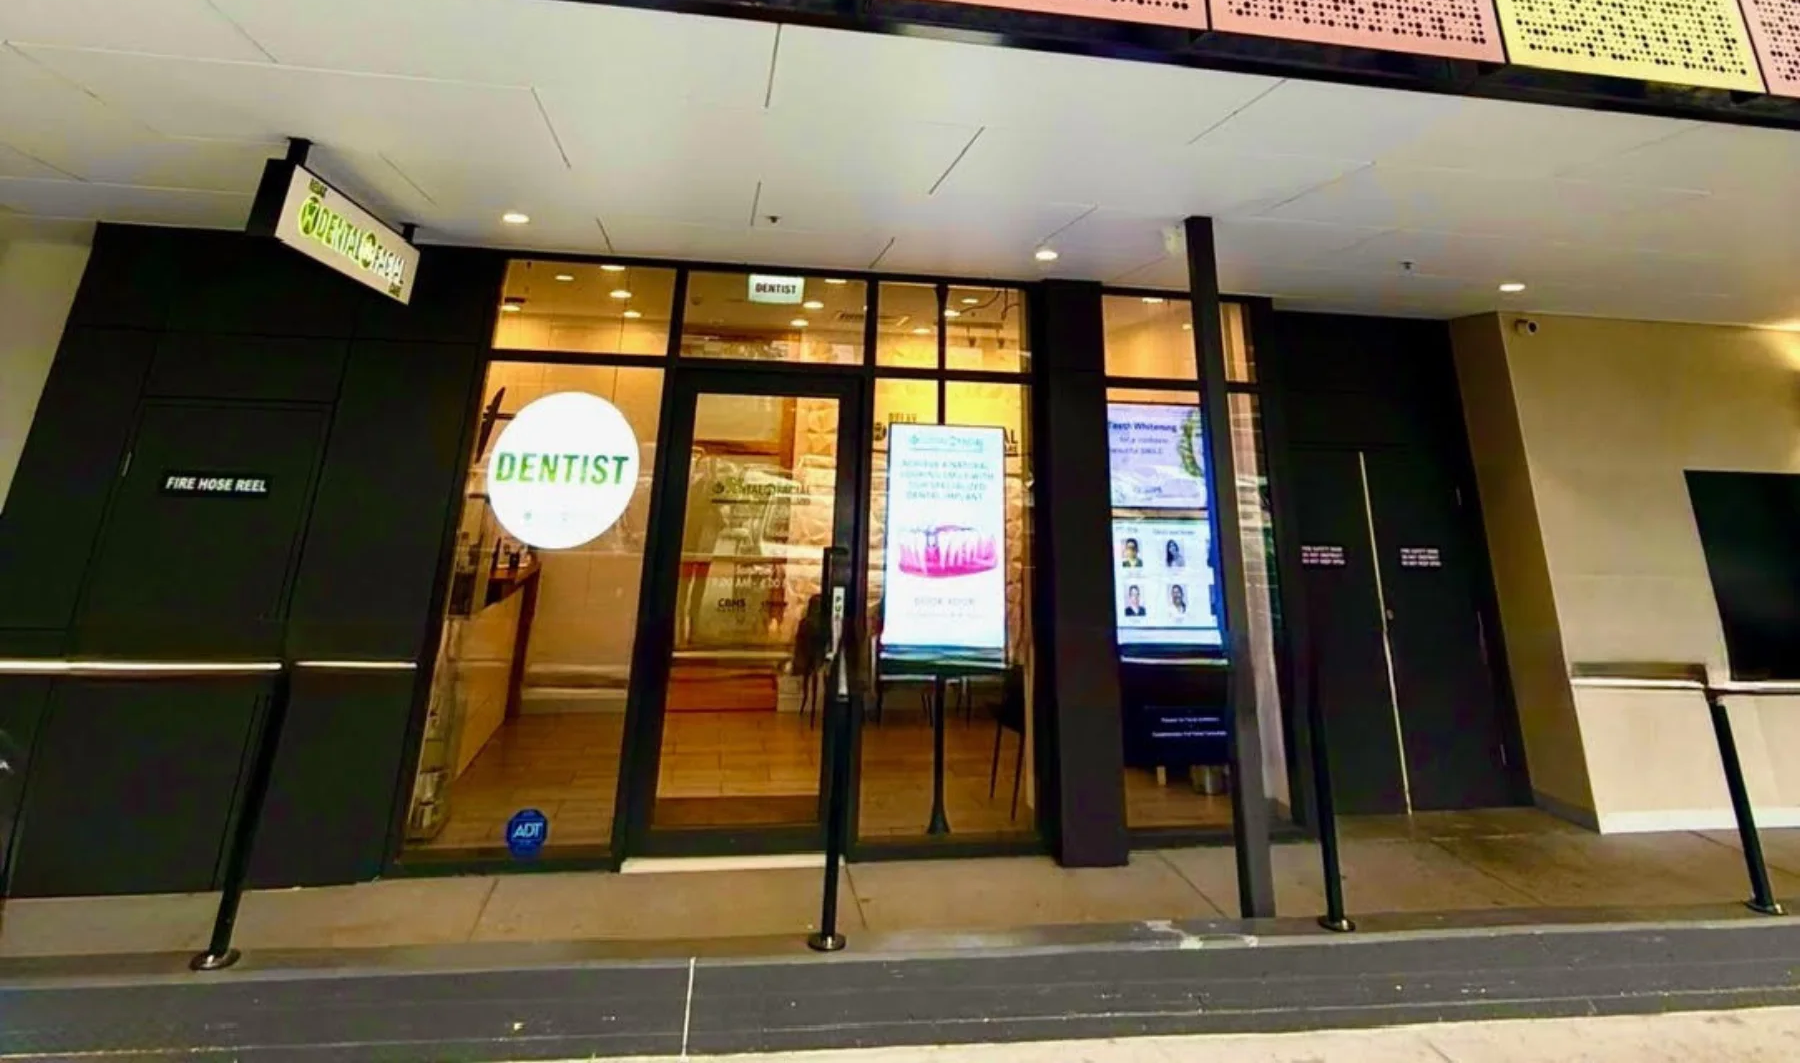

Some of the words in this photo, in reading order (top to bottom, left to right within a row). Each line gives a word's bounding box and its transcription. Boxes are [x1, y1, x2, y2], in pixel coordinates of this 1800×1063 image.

[755, 282, 797, 295] DENTIST
[1134, 422, 1177, 433] Whitening
[495, 452, 630, 485] DENTIST
[165, 476, 197, 490] FIRE
[197, 477, 234, 491] HOSE
[234, 478, 267, 493] REEL
[512, 822, 544, 838] ADT
